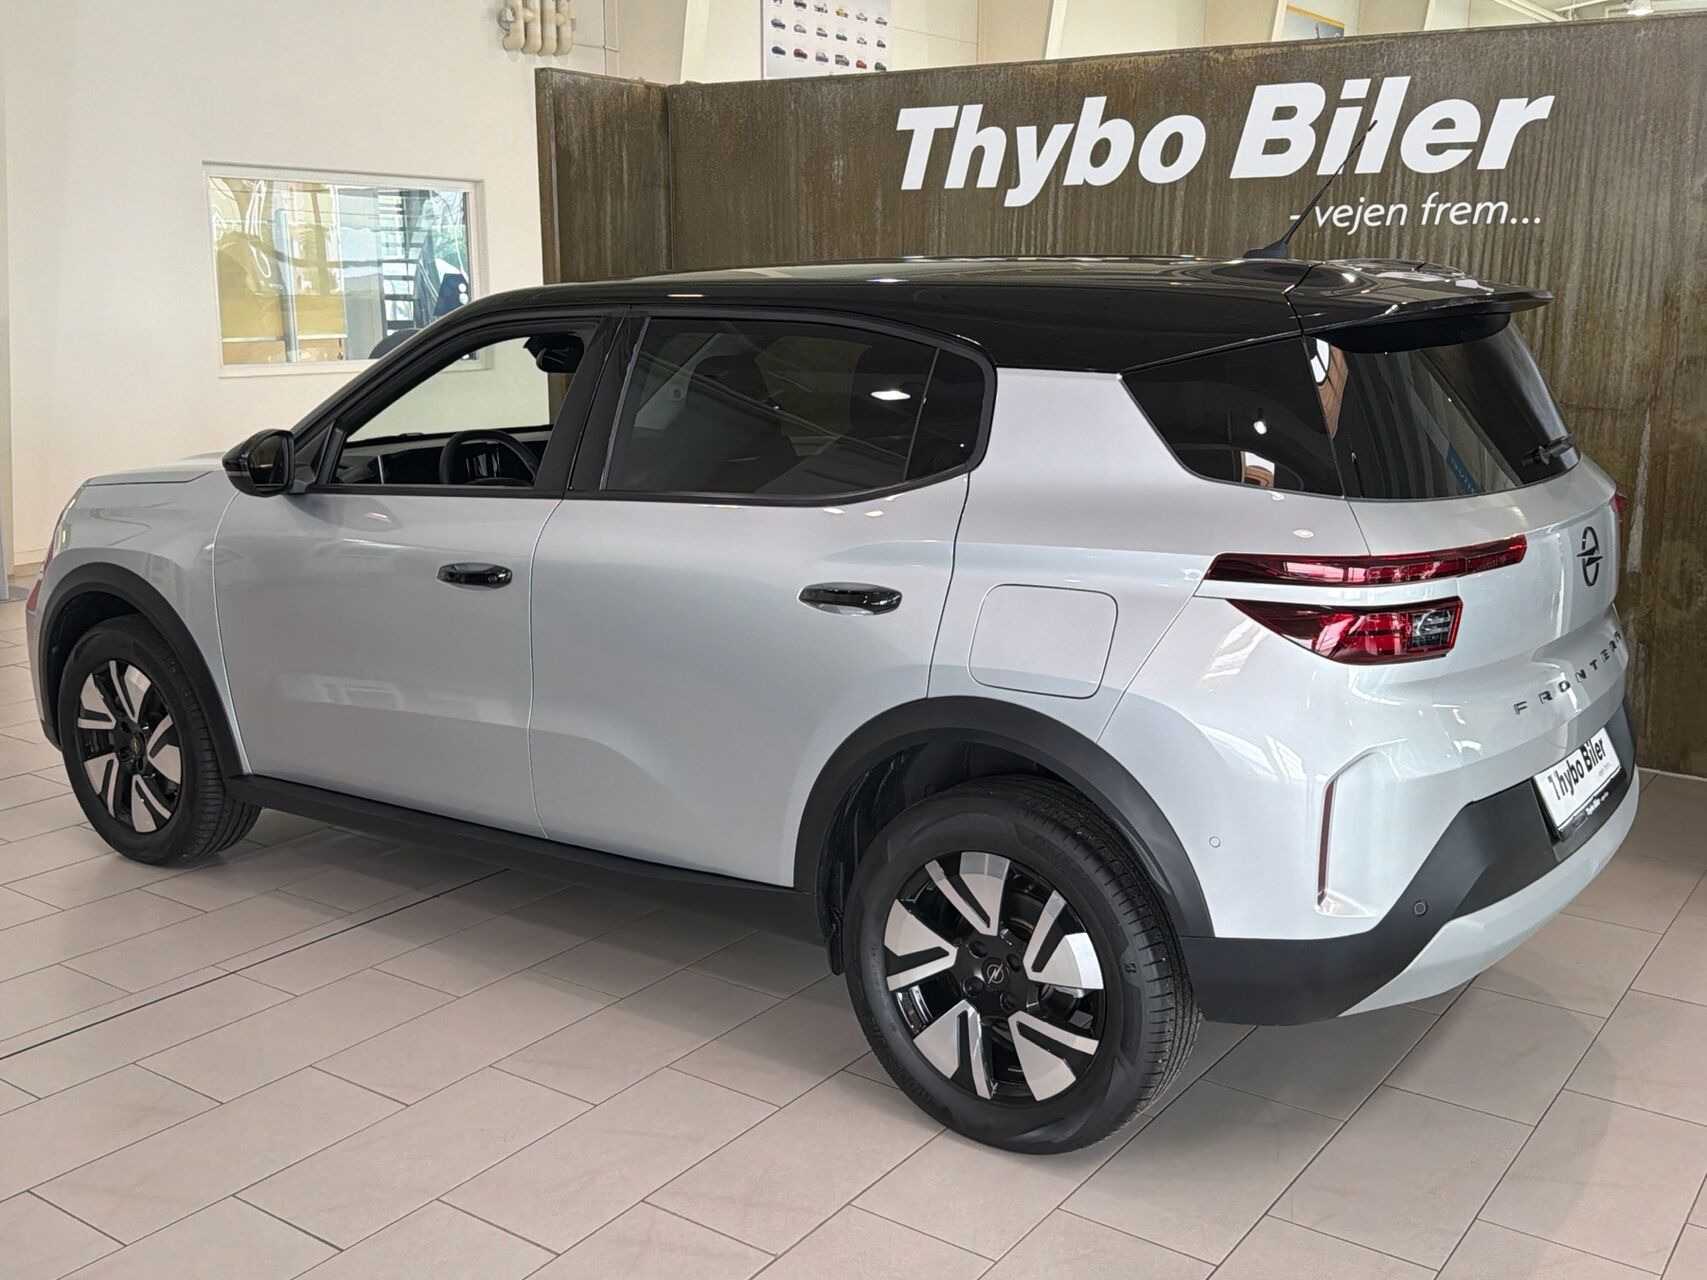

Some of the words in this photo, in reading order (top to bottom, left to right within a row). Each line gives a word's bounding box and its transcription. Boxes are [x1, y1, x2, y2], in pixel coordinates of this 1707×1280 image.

[896, 96, 1206, 207] Thybo
[1229, 75, 1556, 179] Biler
[1314, 196, 1408, 235] vejen
[1421, 191, 1541, 226] frem...
[1513, 631, 1622, 715] FRONTERA
[1579, 738, 1606, 771] Biler
